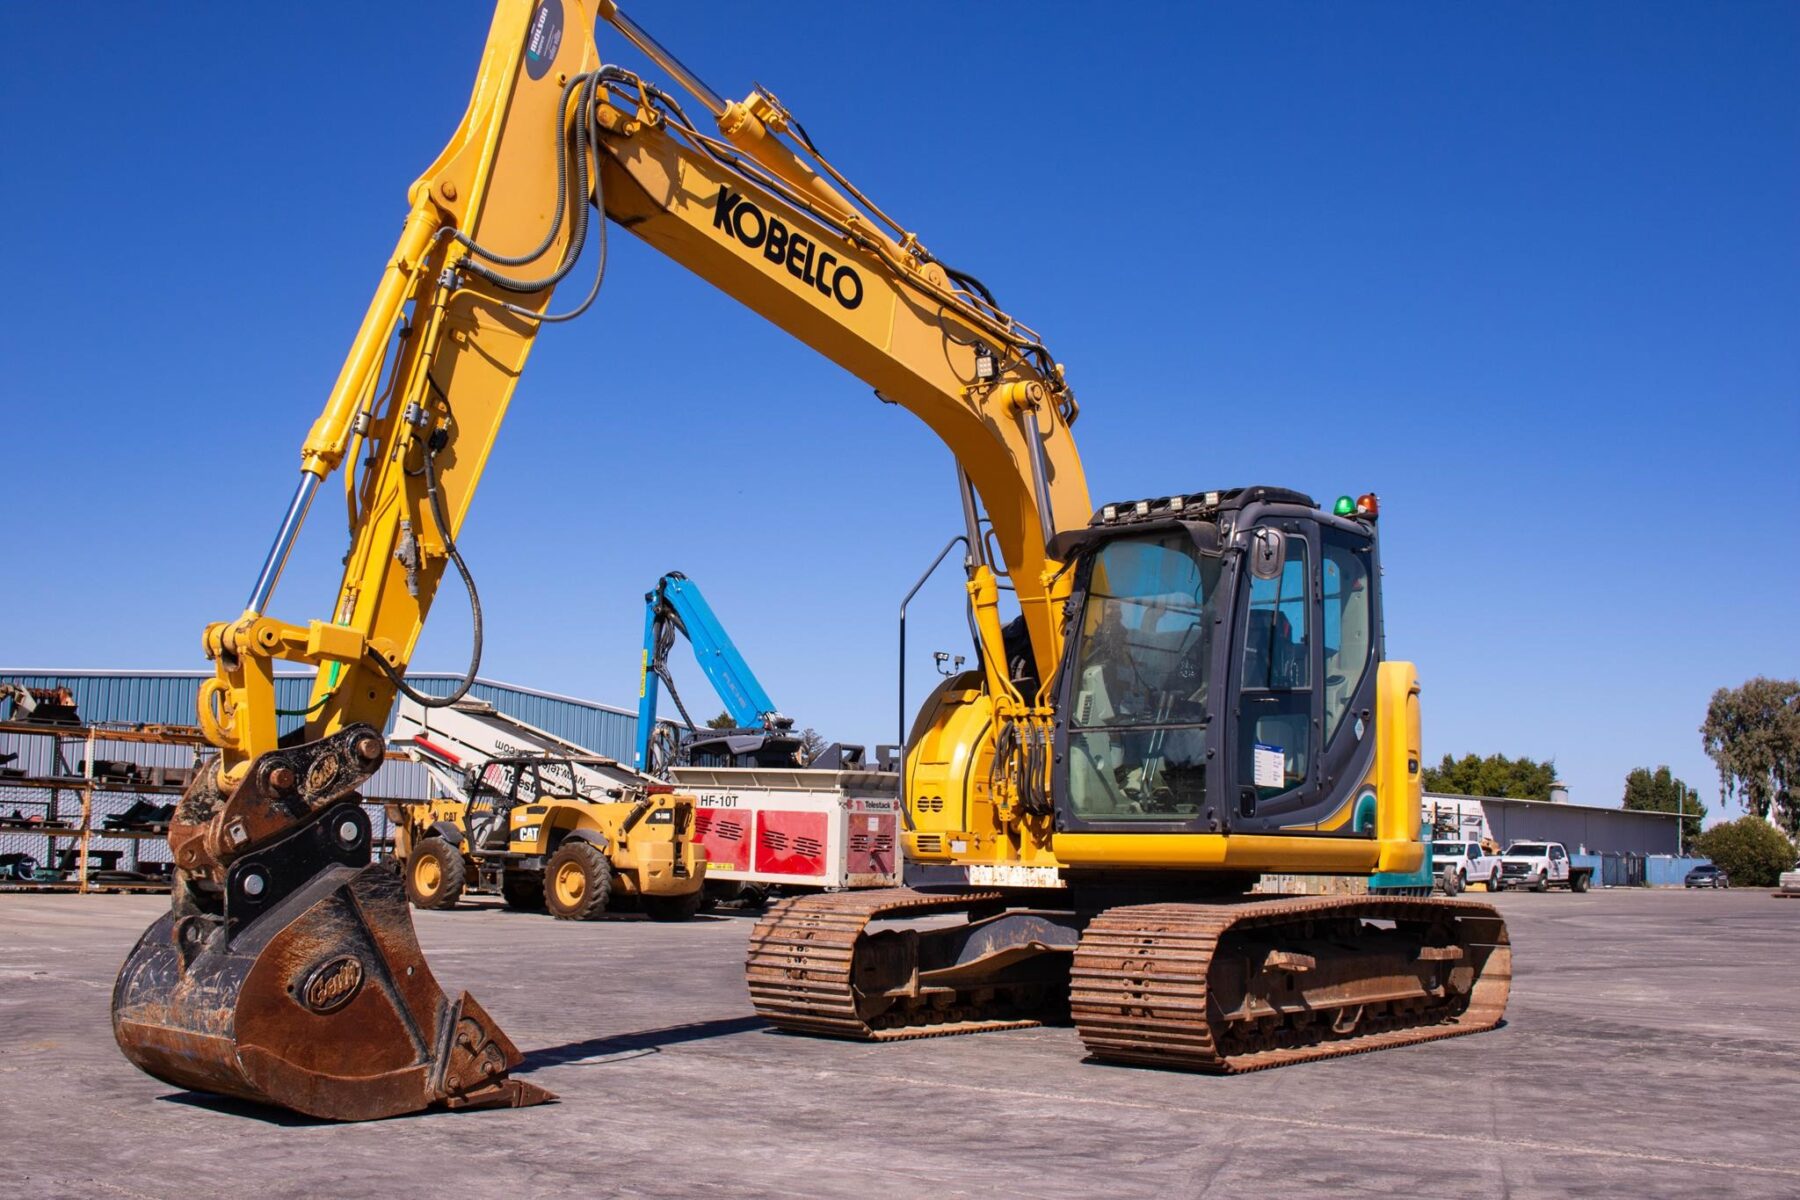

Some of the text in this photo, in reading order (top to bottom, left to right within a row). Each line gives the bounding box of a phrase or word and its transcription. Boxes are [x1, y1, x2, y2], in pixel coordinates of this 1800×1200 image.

[713, 184, 863, 310] KOBELCO
[700, 795, 738, 807] HF-10T
[443, 811, 457, 821] CAT
[520, 827, 539, 841] CAT
